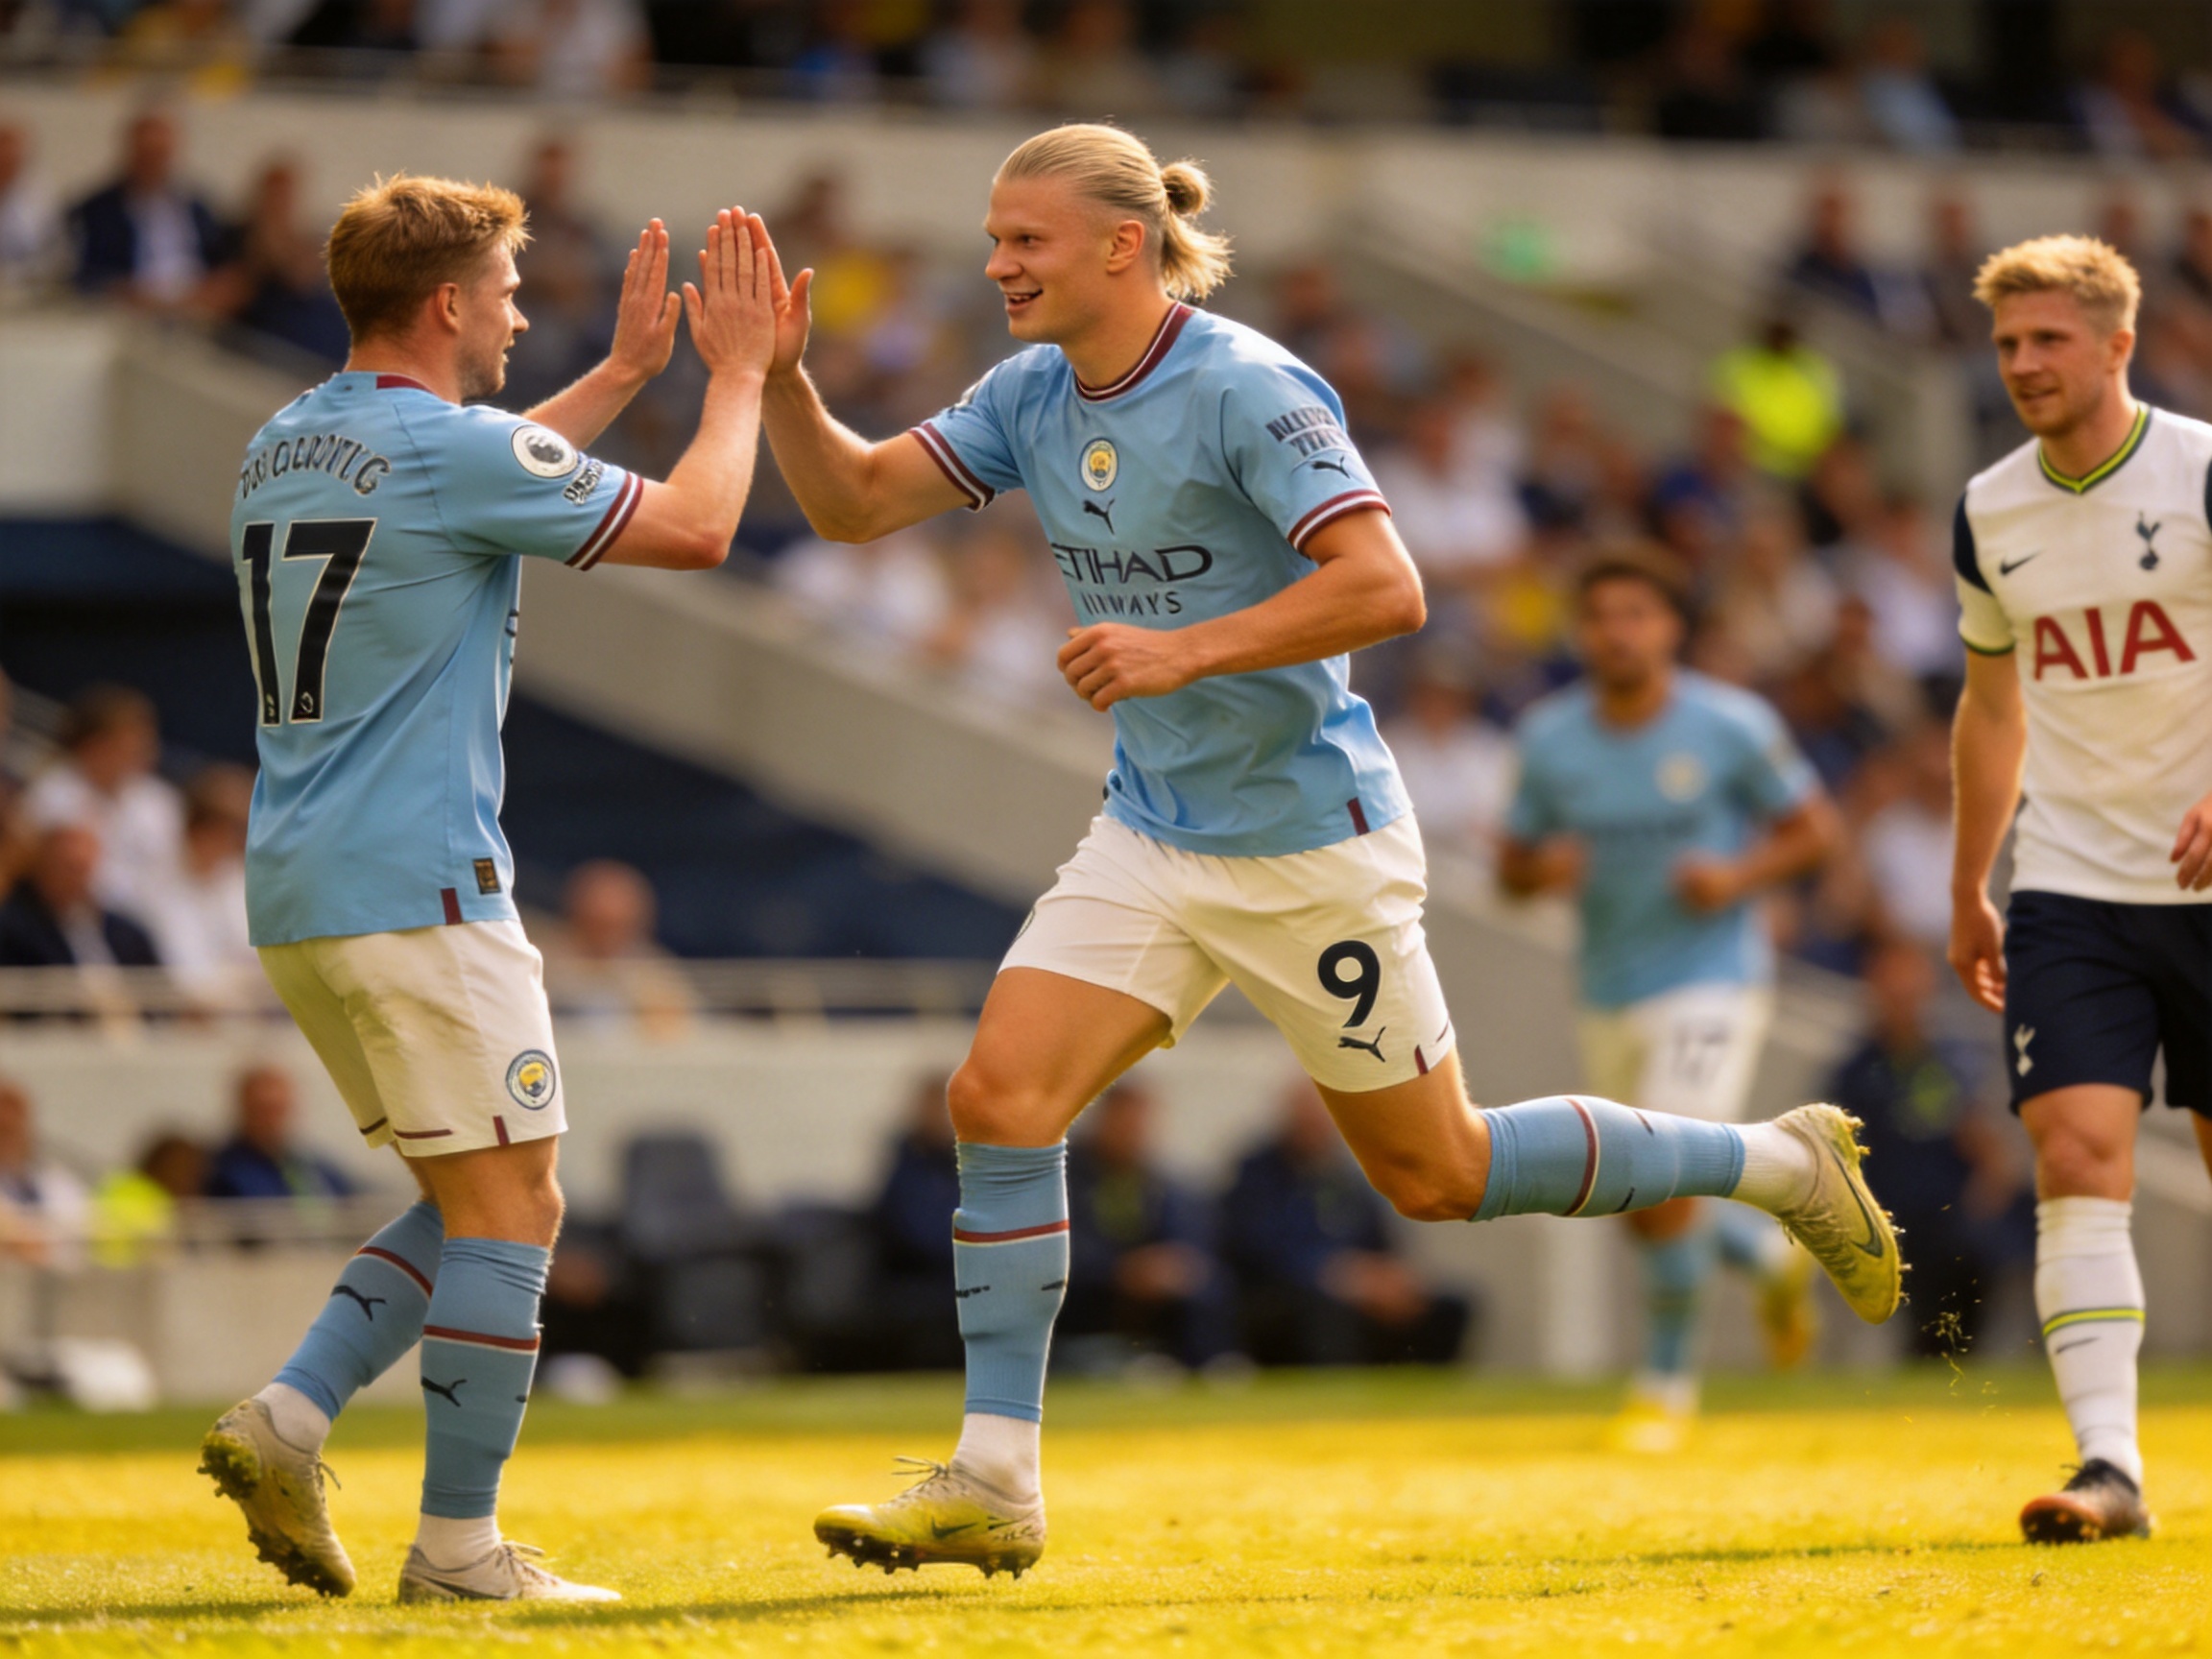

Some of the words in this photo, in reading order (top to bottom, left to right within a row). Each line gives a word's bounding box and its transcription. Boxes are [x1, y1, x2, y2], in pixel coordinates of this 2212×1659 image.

[1051, 542, 1213, 584] ETIHAD
[242, 517, 377, 726] 17
[2033, 599, 2197, 681] AIA
[1317, 940, 1381, 1028] 9
